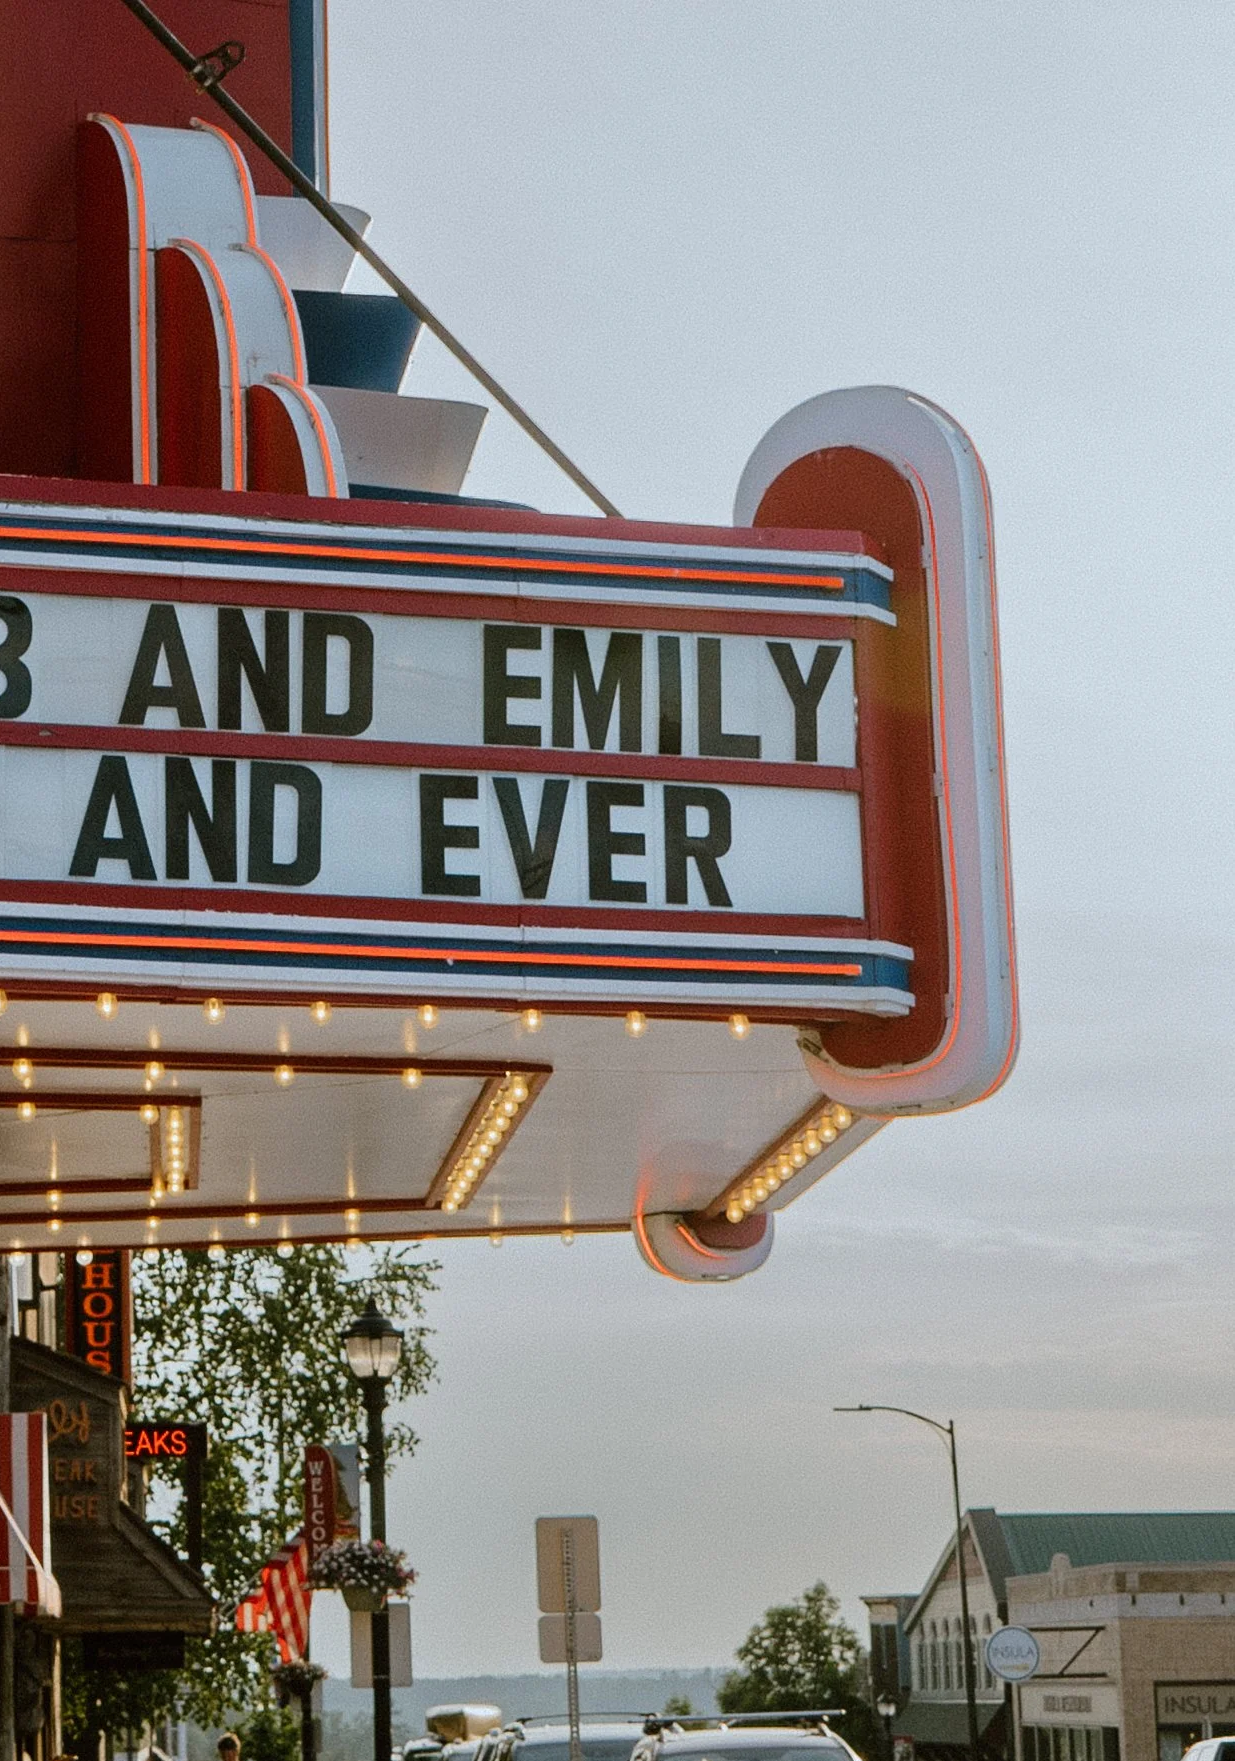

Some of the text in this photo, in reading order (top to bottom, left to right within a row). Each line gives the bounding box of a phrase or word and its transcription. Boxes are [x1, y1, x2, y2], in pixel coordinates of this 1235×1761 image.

[118, 603, 374, 737] AND
[483, 624, 842, 762] EMILY
[68, 755, 322, 887] AND
[419, 773, 733, 908] EVER
[124, 1430, 187, 1457] EAKS
